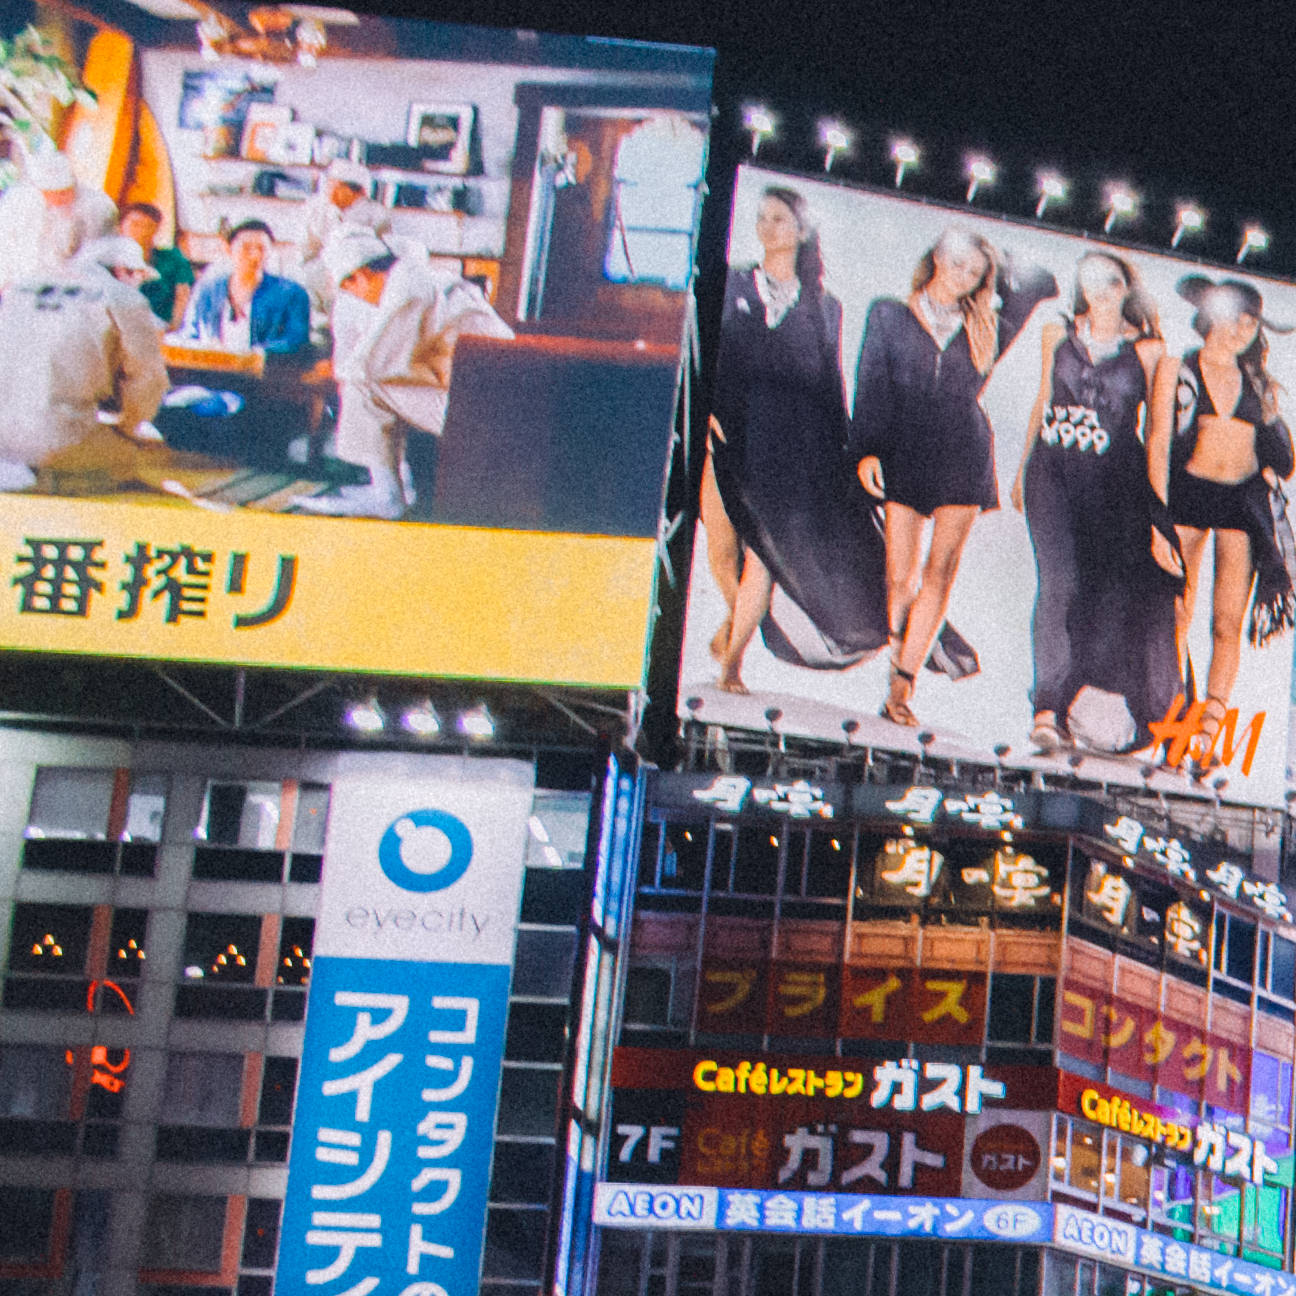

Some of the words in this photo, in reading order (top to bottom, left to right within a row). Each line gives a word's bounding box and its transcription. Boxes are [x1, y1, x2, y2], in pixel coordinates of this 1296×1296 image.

[345, 901, 491, 940] eyecity
[705, 969, 971, 1024] プライス
[1062, 990, 1242, 1092] コンタクト
[870, 1058, 1006, 1114] ガスト
[616, 1124, 680, 1164] 7F
[778, 1124, 946, 1188] ガスト
[1194, 1121, 1278, 1186] ガスト
[607, 1190, 704, 1220] AEON
[724, 1194, 975, 1234] 英会話イーオン
[1062, 1214, 1131, 1256] AEON
